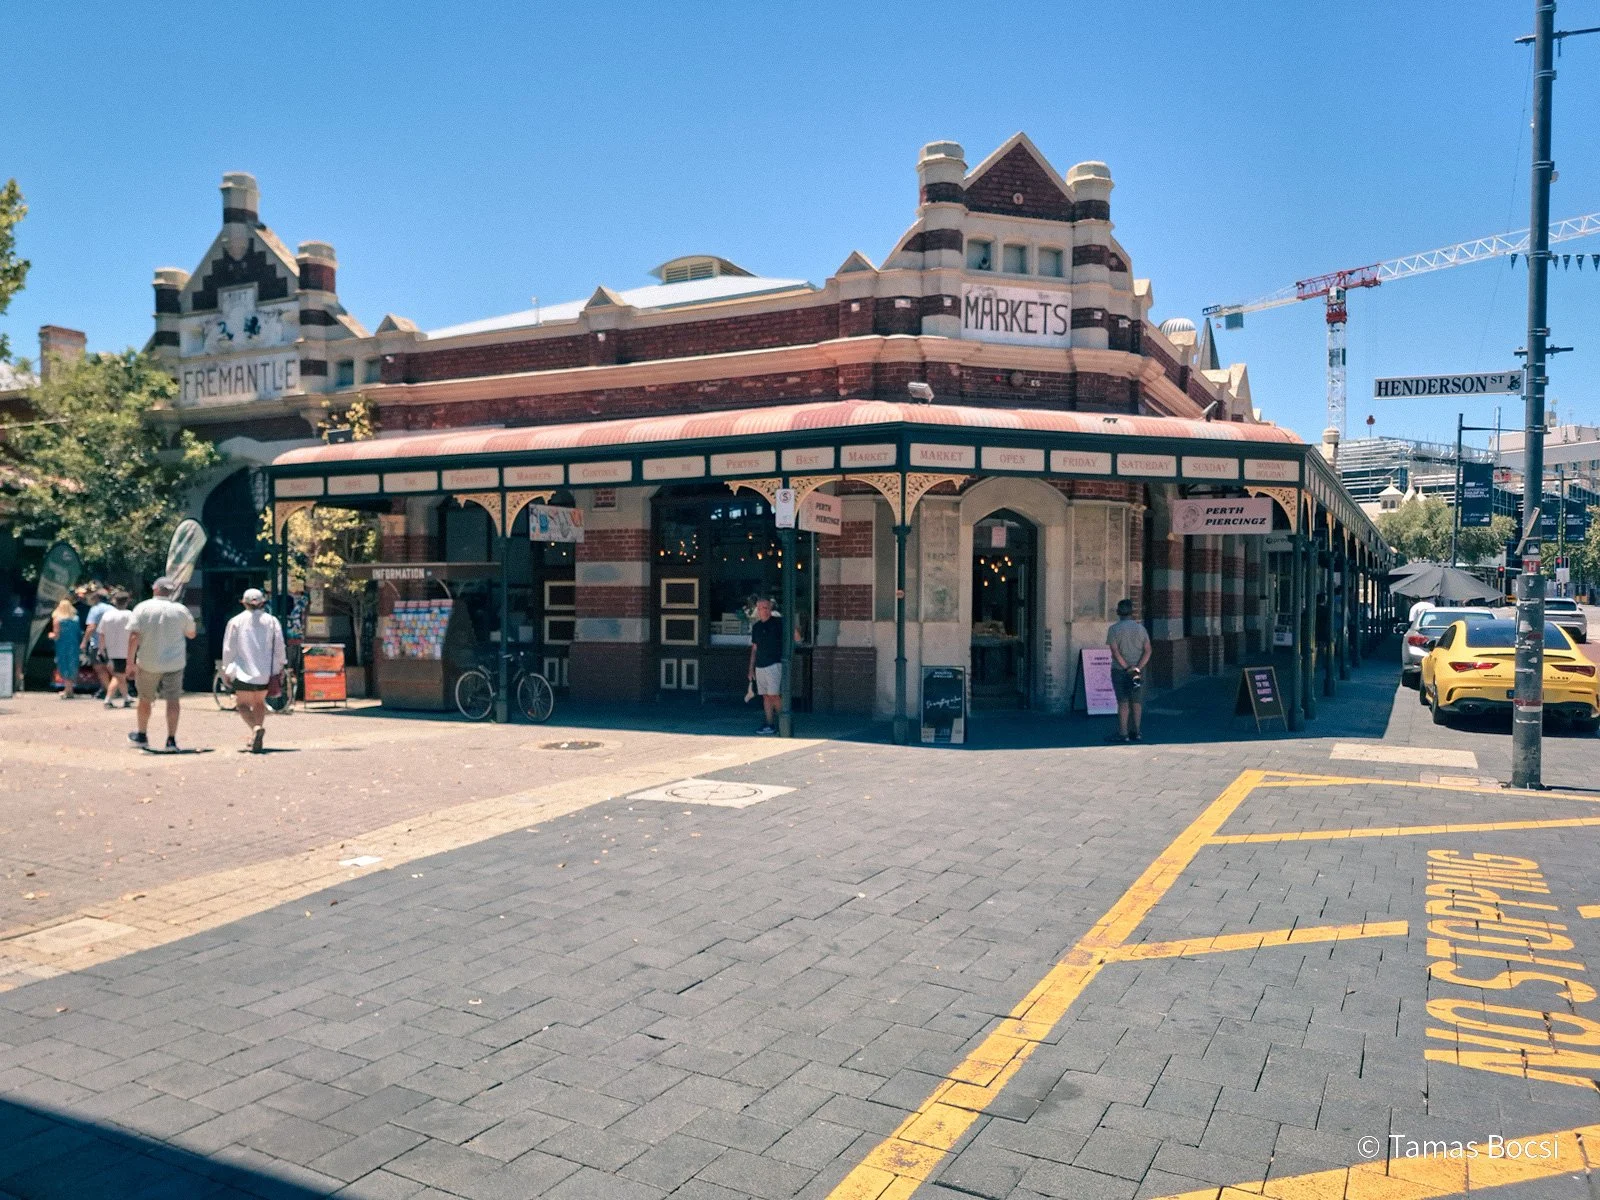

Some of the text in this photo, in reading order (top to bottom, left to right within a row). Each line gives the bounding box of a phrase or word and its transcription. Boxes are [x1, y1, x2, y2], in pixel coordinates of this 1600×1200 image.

[964, 295, 1068, 337] MARKETS
[183, 359, 297, 400] FREMANTLE
[1377, 375, 1505, 397] HENDERSON ST
[795, 455, 819, 465] BEST
[848, 451, 889, 462] MARKET
[919, 450, 1228, 473] MARKET OPEN FRIDAY SATURDAY SUNDAY
[1205, 506, 1244, 515] PERTH
[1205, 518, 1267, 527] PIERCINGZ
[372, 568, 425, 580] INFORMATION
[1424, 848, 1600, 1089] NO STOPPING
